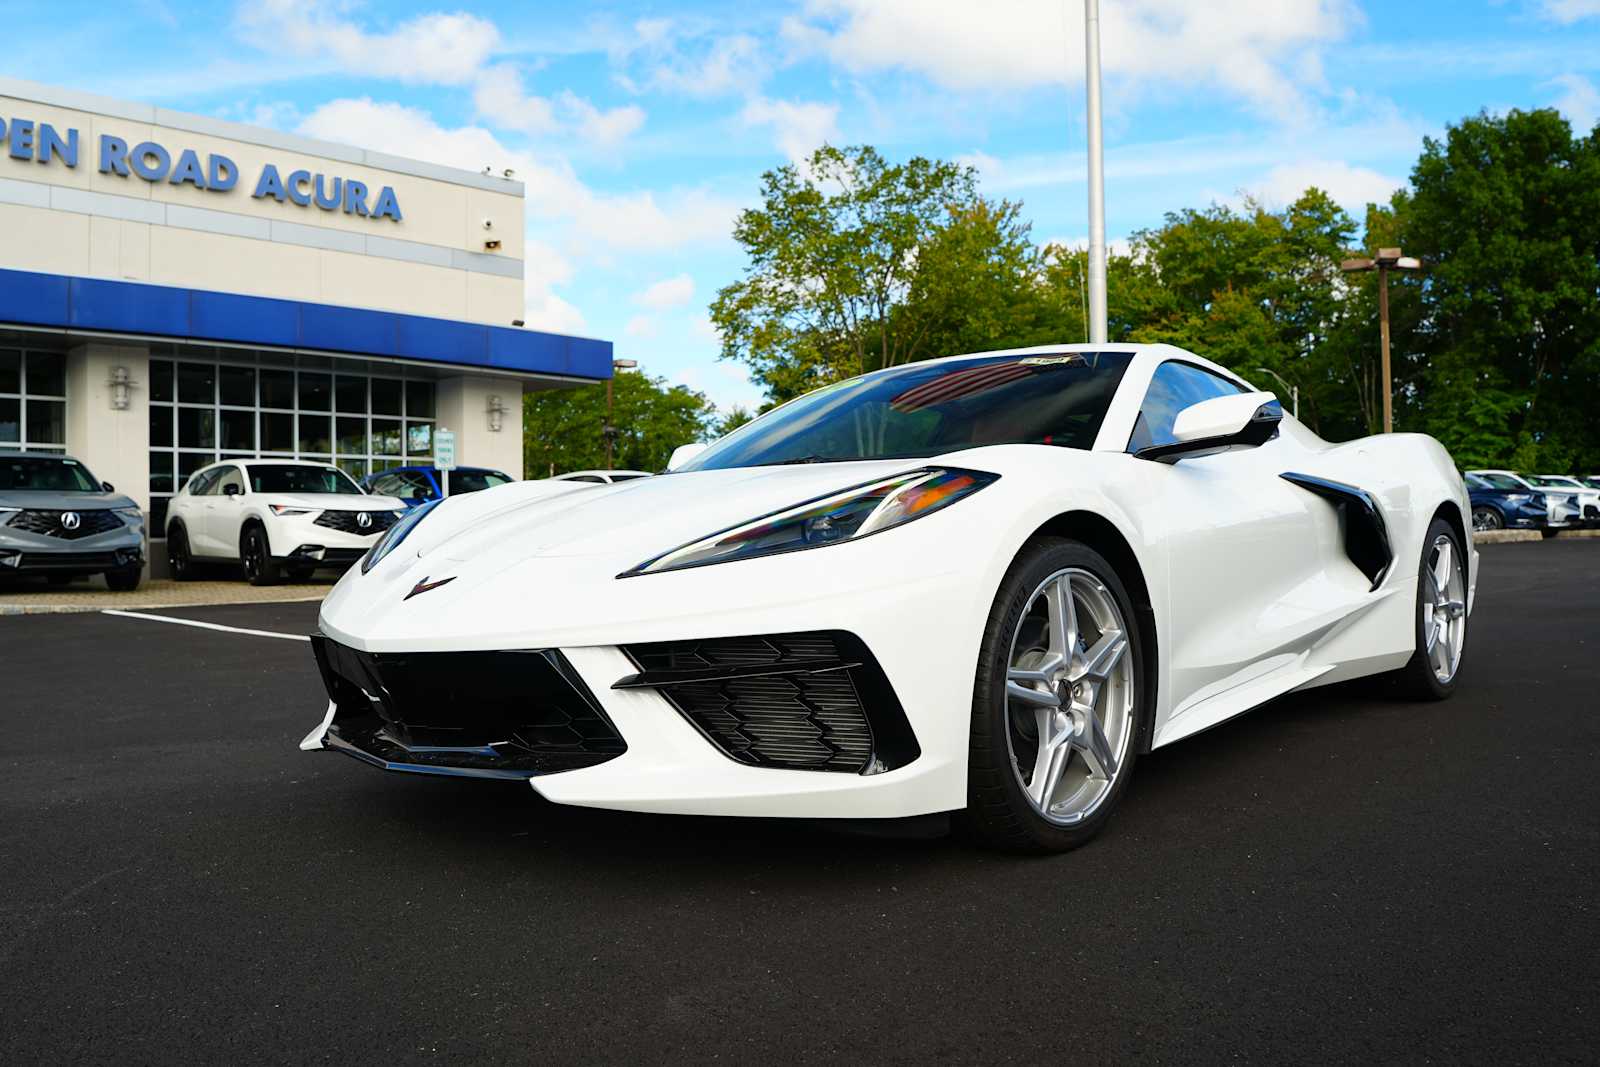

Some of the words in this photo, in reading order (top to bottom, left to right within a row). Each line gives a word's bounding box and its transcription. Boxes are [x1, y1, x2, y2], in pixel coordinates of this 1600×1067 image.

[0, 117, 78, 168] EN
[98, 134, 239, 192] ROAD
[252, 163, 402, 222] ACURA
